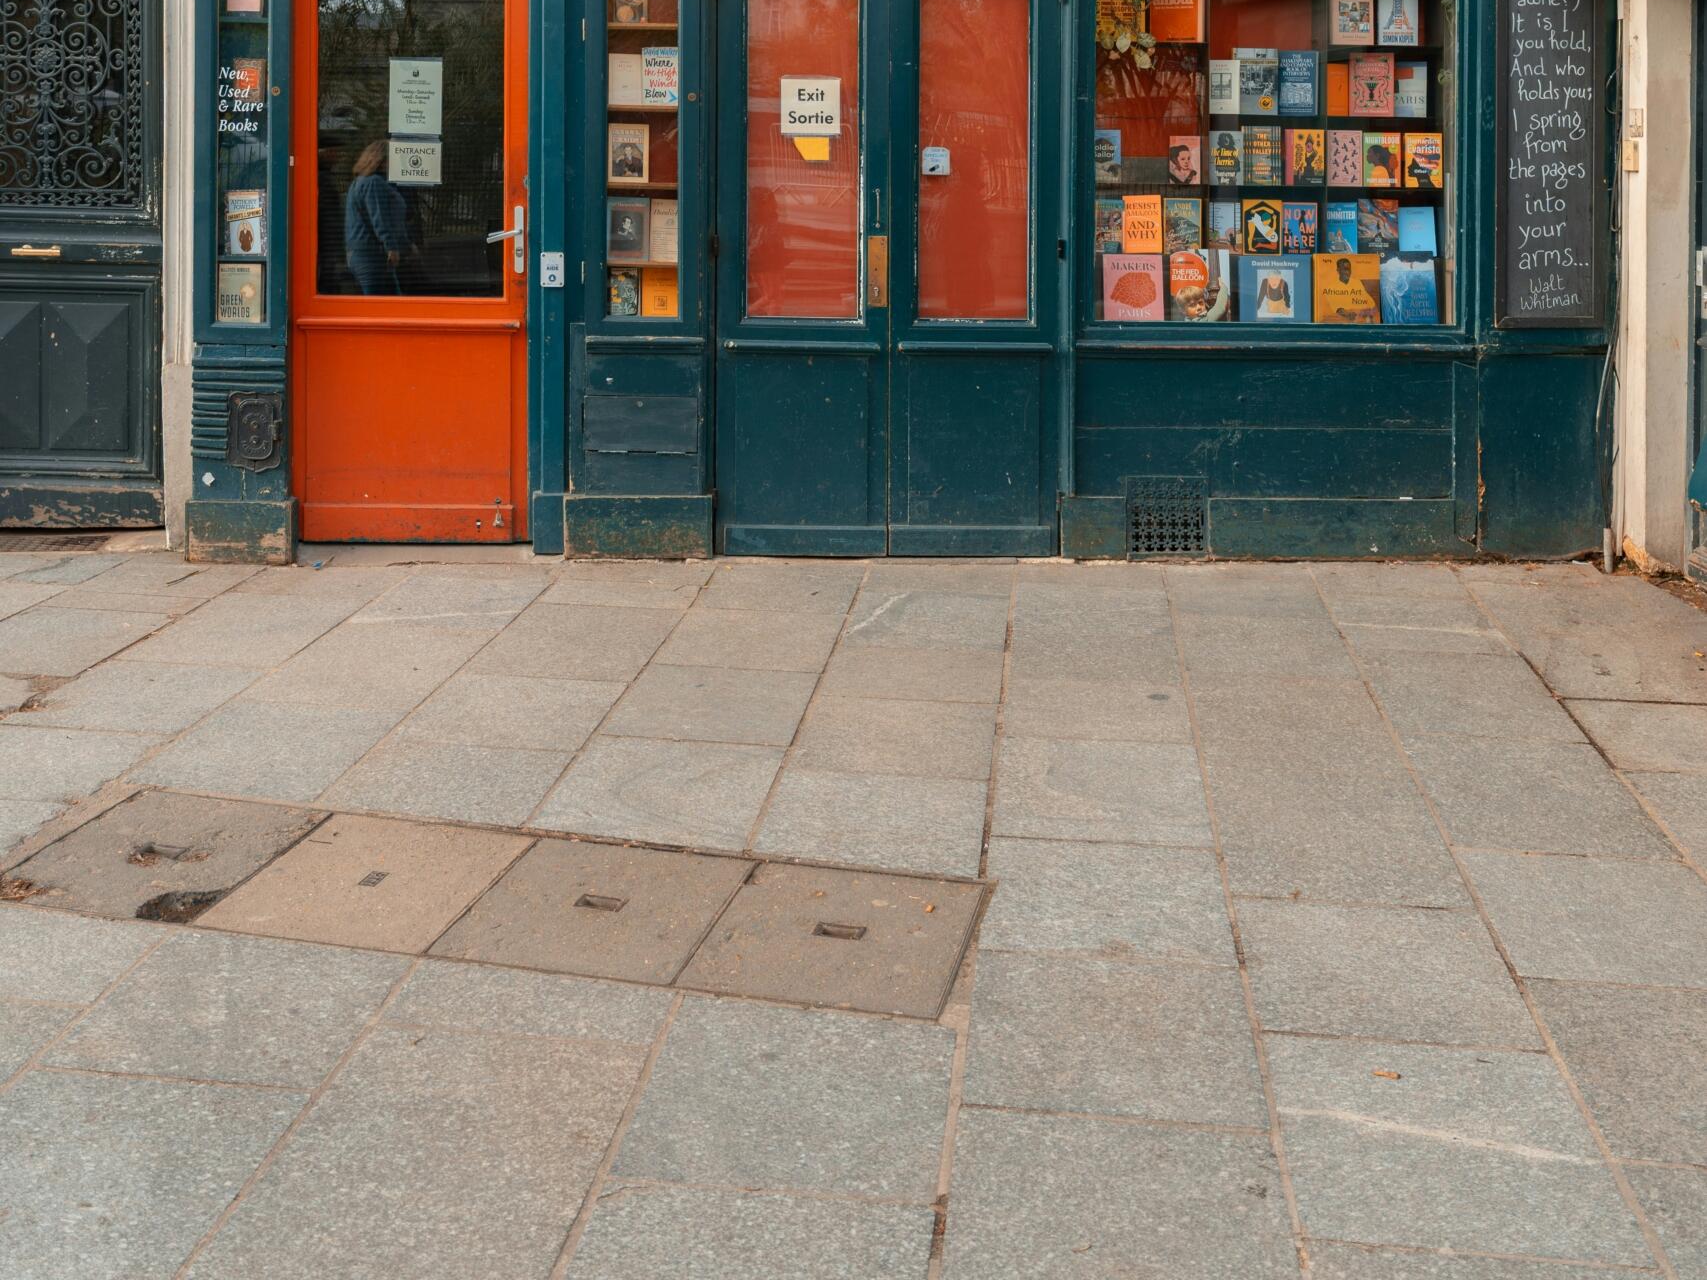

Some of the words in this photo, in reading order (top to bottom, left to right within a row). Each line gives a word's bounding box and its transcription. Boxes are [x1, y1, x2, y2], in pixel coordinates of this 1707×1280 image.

[1512, 12, 1524, 32] It
[1537, 13, 1552, 32] is
[1563, 9, 1569, 32] I
[1514, 38, 1544, 57] you
[1550, 31, 1591, 52] hold,
[645, 58, 673, 68] Where
[1510, 57, 1547, 77] And
[1555, 56, 1585, 76] who
[218, 66, 249, 82] New,
[218, 84, 251, 98] Used
[645, 89, 667, 98] Blow
[797, 88, 825, 101] Exit
[1518, 78, 1559, 102] holds
[218, 99, 229, 112] &
[232, 99, 264, 113] Rare
[788, 111, 834, 124] Sortie
[218, 118, 258, 132] Books
[1530, 110, 1586, 140] spring
[395, 147, 436, 155] ENTRANCE
[1524, 132, 1567, 159] from
[401, 168, 429, 177] ENTRÉE
[1509, 158, 1535, 179] the
[1542, 161, 1585, 189] pages
[1126, 202, 1158, 210] RESIST
[1525, 190, 1565, 215] into
[1284, 208, 1315, 220] NOW
[1326, 210, 1356, 220] OMMITTED
[1129, 221, 1155, 230] AND
[1300, 222, 1315, 234] AM
[1127, 230, 1157, 239] WHY
[1518, 222, 1566, 249] your
[1284, 236, 1315, 247] HERE
[1111, 262, 1156, 271] MAKERS
[1271, 260, 1299, 269] Hockney
[1529, 274, 1565, 294] Walt
[1322, 288, 1349, 296] African
[1350, 288, 1362, 296] Art
[221, 294, 243, 305] GREEN
[1520, 292, 1581, 310] Whitman
[1118, 309, 1152, 318] PARIS
